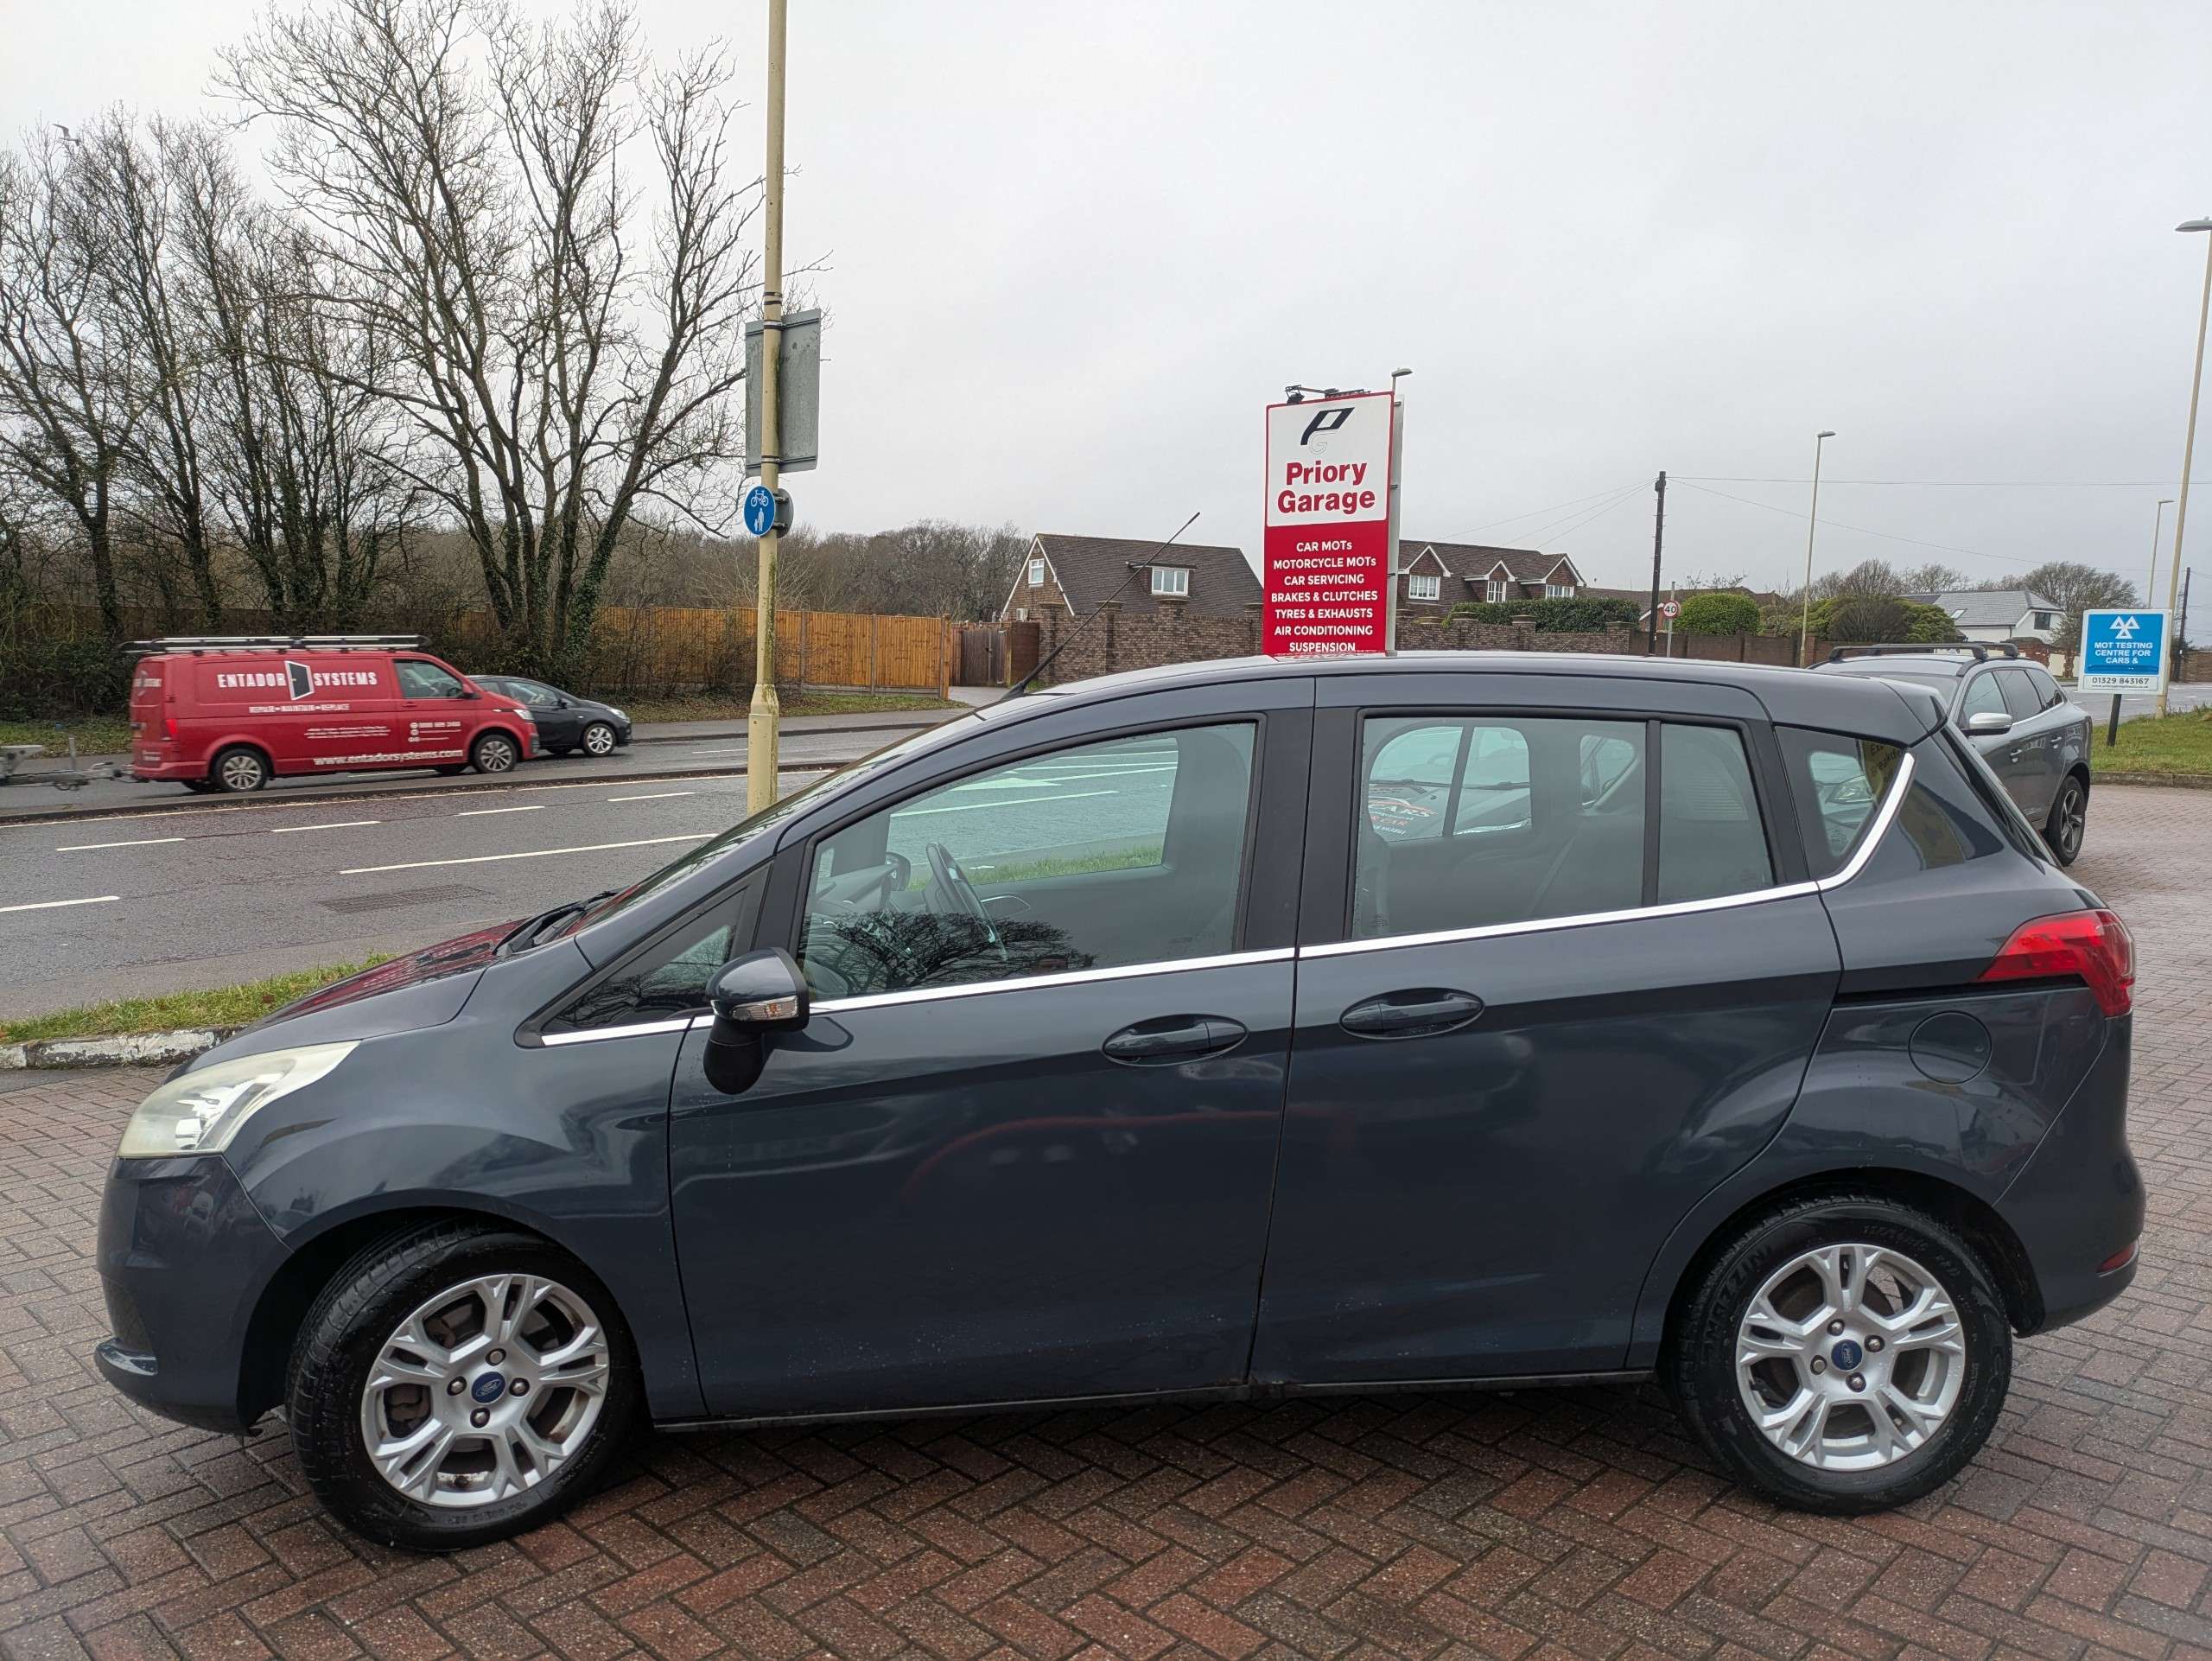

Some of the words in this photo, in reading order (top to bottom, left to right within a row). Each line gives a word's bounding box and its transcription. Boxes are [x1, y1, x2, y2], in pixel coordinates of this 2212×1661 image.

[1286, 460, 1368, 486] Priory
[1277, 490, 1376, 515] Garage
[1296, 541, 1319, 552] CAR
[1321, 540, 1352, 551] MOTs
[1273, 557, 1344, 570] MOTORCYCLE
[1346, 556, 1376, 567] MOTs
[1284, 576, 1305, 586] CAR
[1307, 574, 1364, 585] SERVICING
[1271, 592, 1311, 602] BRAKES
[1313, 591, 1320, 601] &
[1322, 590, 1378, 601] CLUTCHES
[1274, 608, 1306, 619] TYRES
[1307, 608, 1315, 619] &
[1318, 608, 1373, 619] EXHAUSTS
[1274, 626, 1292, 636] AIR
[1294, 625, 1373, 636] CONDITIONING
[1289, 642, 1356, 652] SUSPENSION
[217, 672, 288, 688] ENTADOR
[313, 671, 378, 686] SYSTEMS
[313, 749, 464, 765] www.entadorsystems.com
